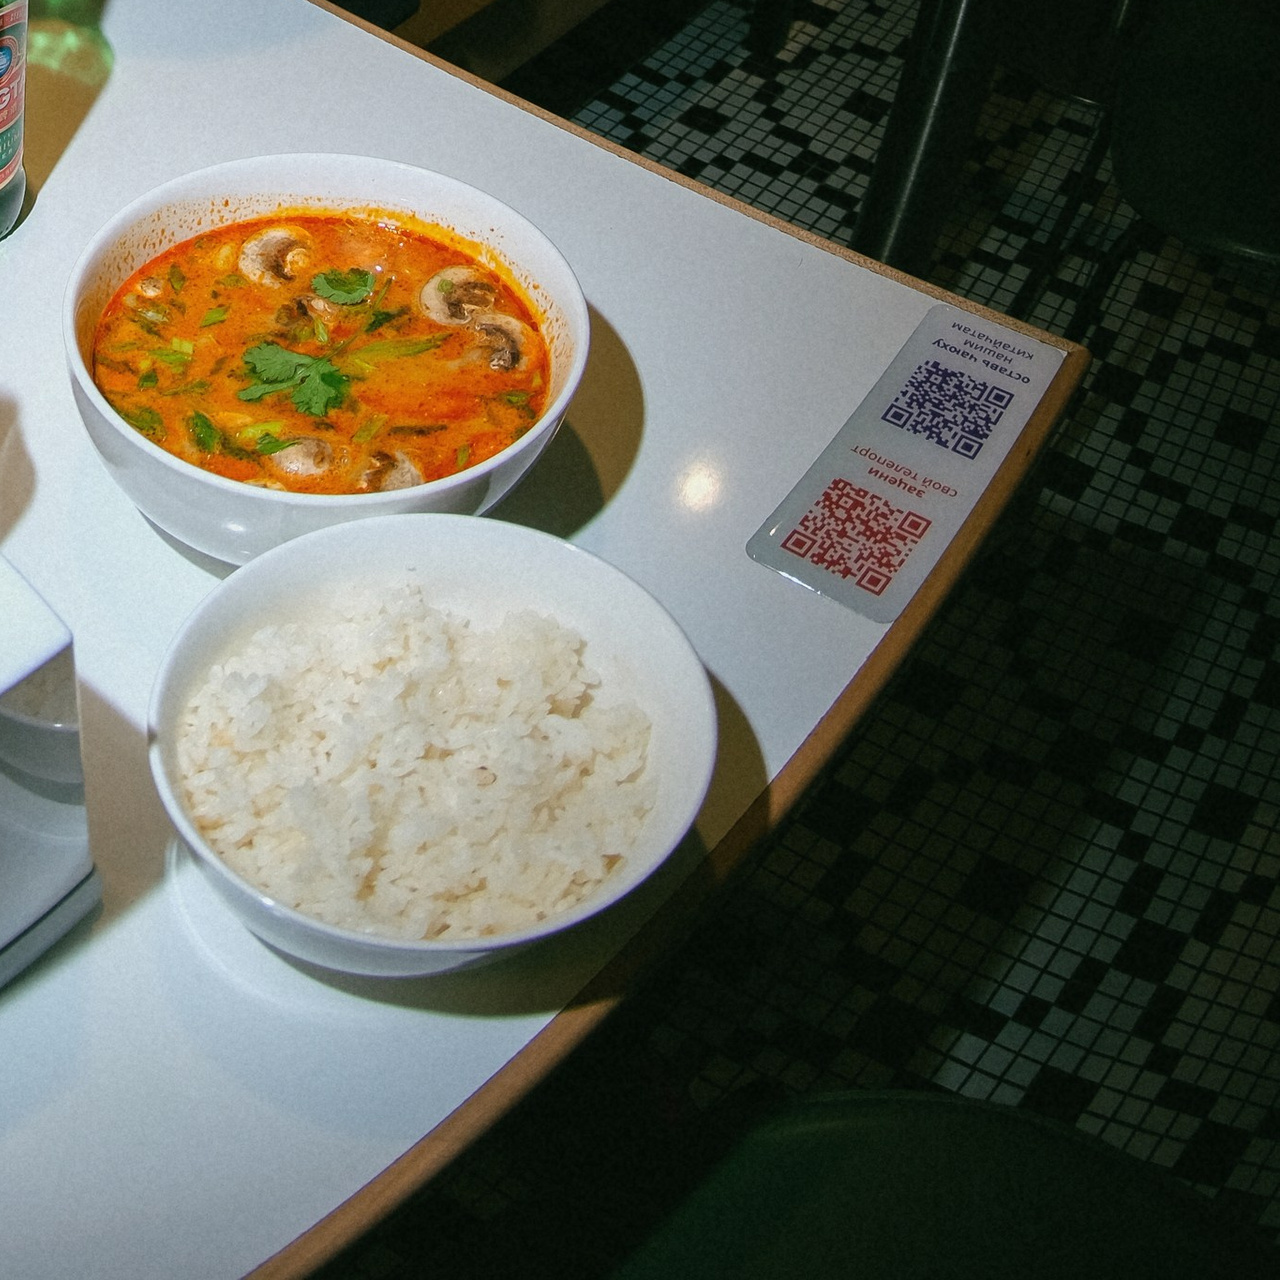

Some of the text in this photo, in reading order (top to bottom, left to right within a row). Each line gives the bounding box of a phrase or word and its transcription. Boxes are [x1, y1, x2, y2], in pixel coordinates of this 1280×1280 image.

[951, 321, 1034, 360] китайчатам
[963, 339, 1014, 364] нашим
[931, 338, 1031, 384] оставь чаюху
[850, 445, 958, 498] свой телепорт
[867, 467, 926, 498] зацени
